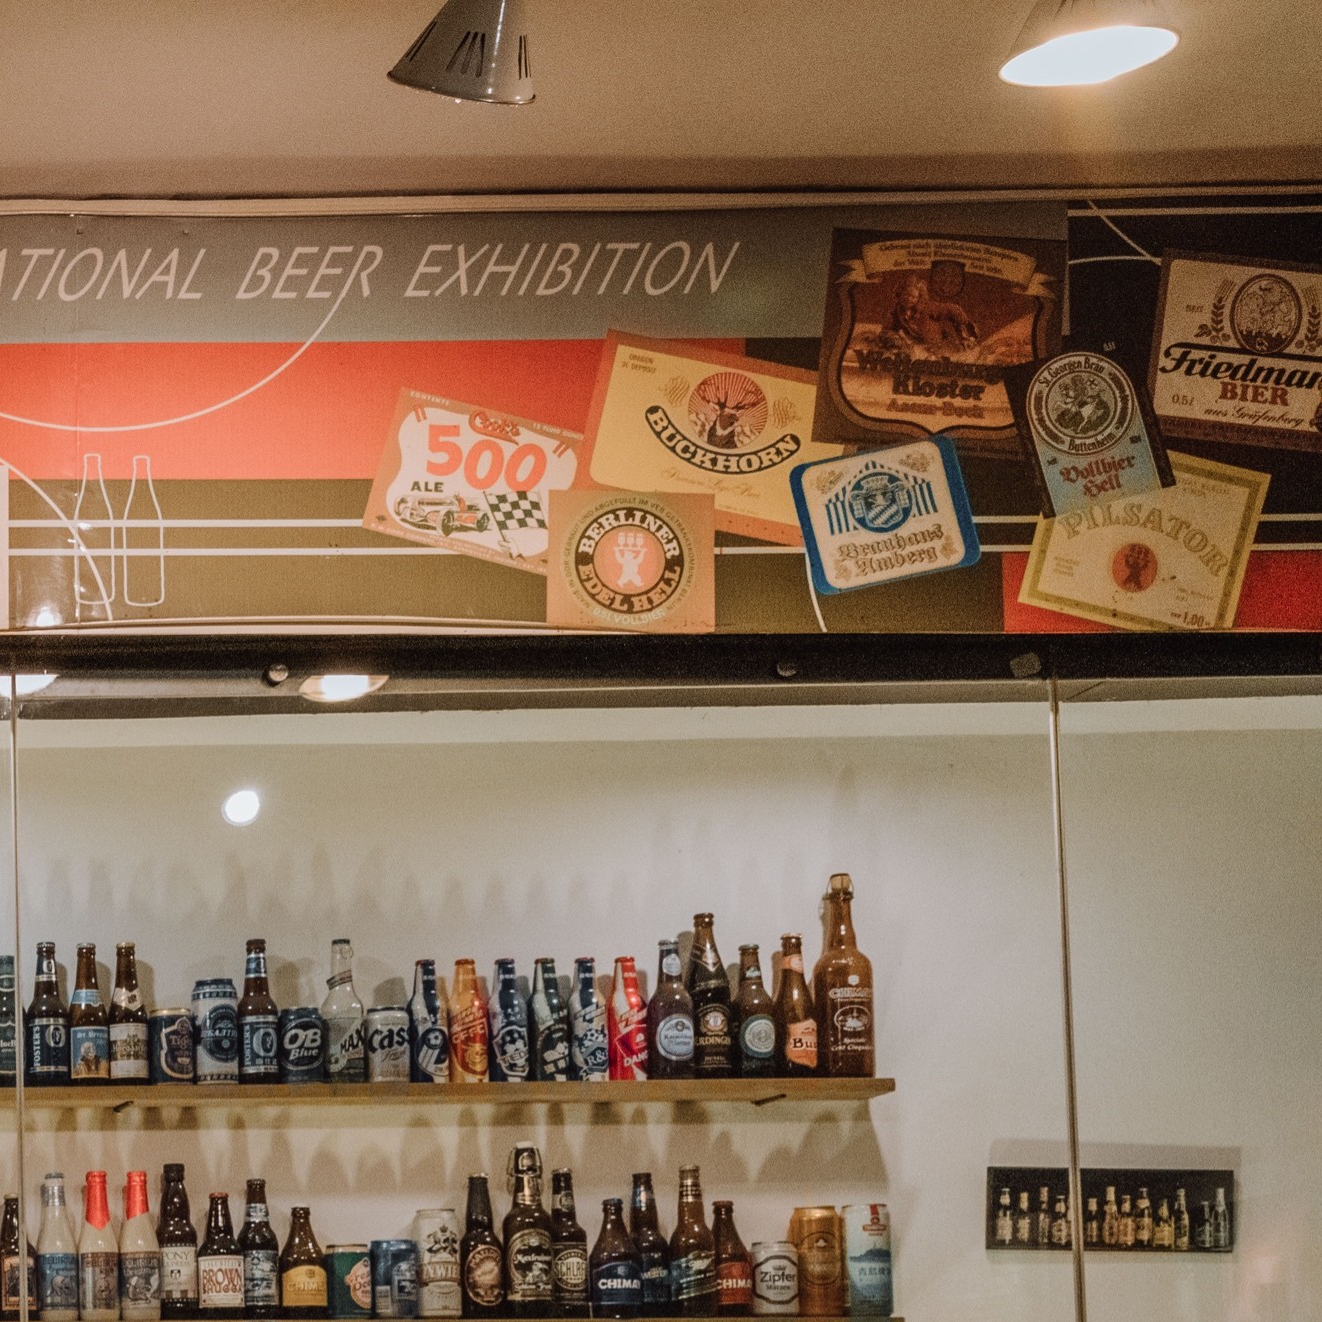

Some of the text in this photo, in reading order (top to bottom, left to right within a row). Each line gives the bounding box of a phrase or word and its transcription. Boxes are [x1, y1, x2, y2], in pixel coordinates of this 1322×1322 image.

[235, 243, 384, 301] BEER
[404, 240, 740, 298] EXHIBITION
[891, 373, 987, 403] Kloster
[1218, 380, 1292, 407] BIER
[647, 406, 800, 474] BUCKHORN
[426, 424, 548, 494] 500
[410, 480, 445, 494] ALE
[576, 509, 682, 562] BERLINER
[1059, 499, 1230, 578] PILSATOR
[283, 1028, 322, 1048] OB
[201, 1268, 242, 1284] BROWN
[760, 1271, 797, 1285] Zipfer
